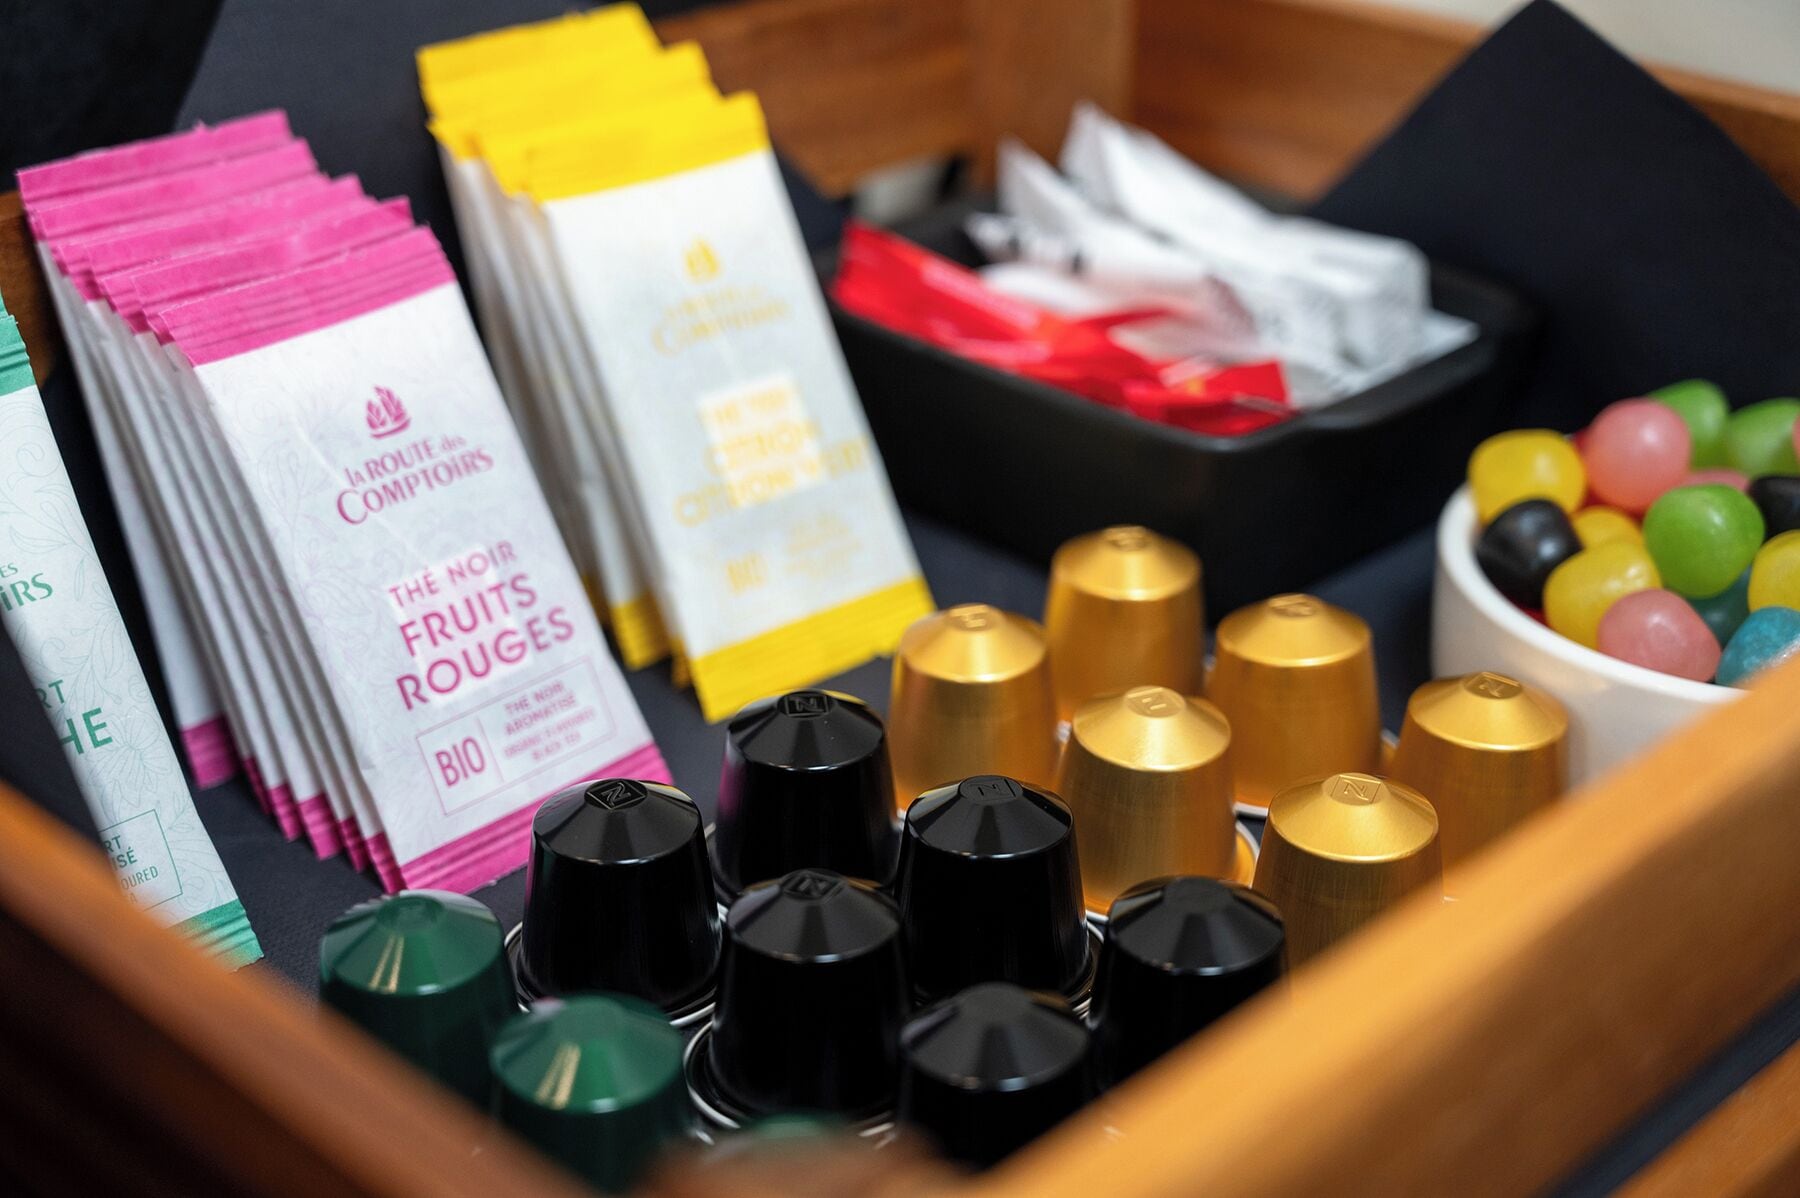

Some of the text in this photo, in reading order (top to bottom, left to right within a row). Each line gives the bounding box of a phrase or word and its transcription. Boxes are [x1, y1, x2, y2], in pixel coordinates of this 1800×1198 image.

[364, 439, 438, 481] ROUTE
[446, 540, 518, 586] NOIR
[400, 573, 537, 657] FRUITS
[396, 607, 574, 711] ROUGES
[435, 737, 485, 787] BIO
